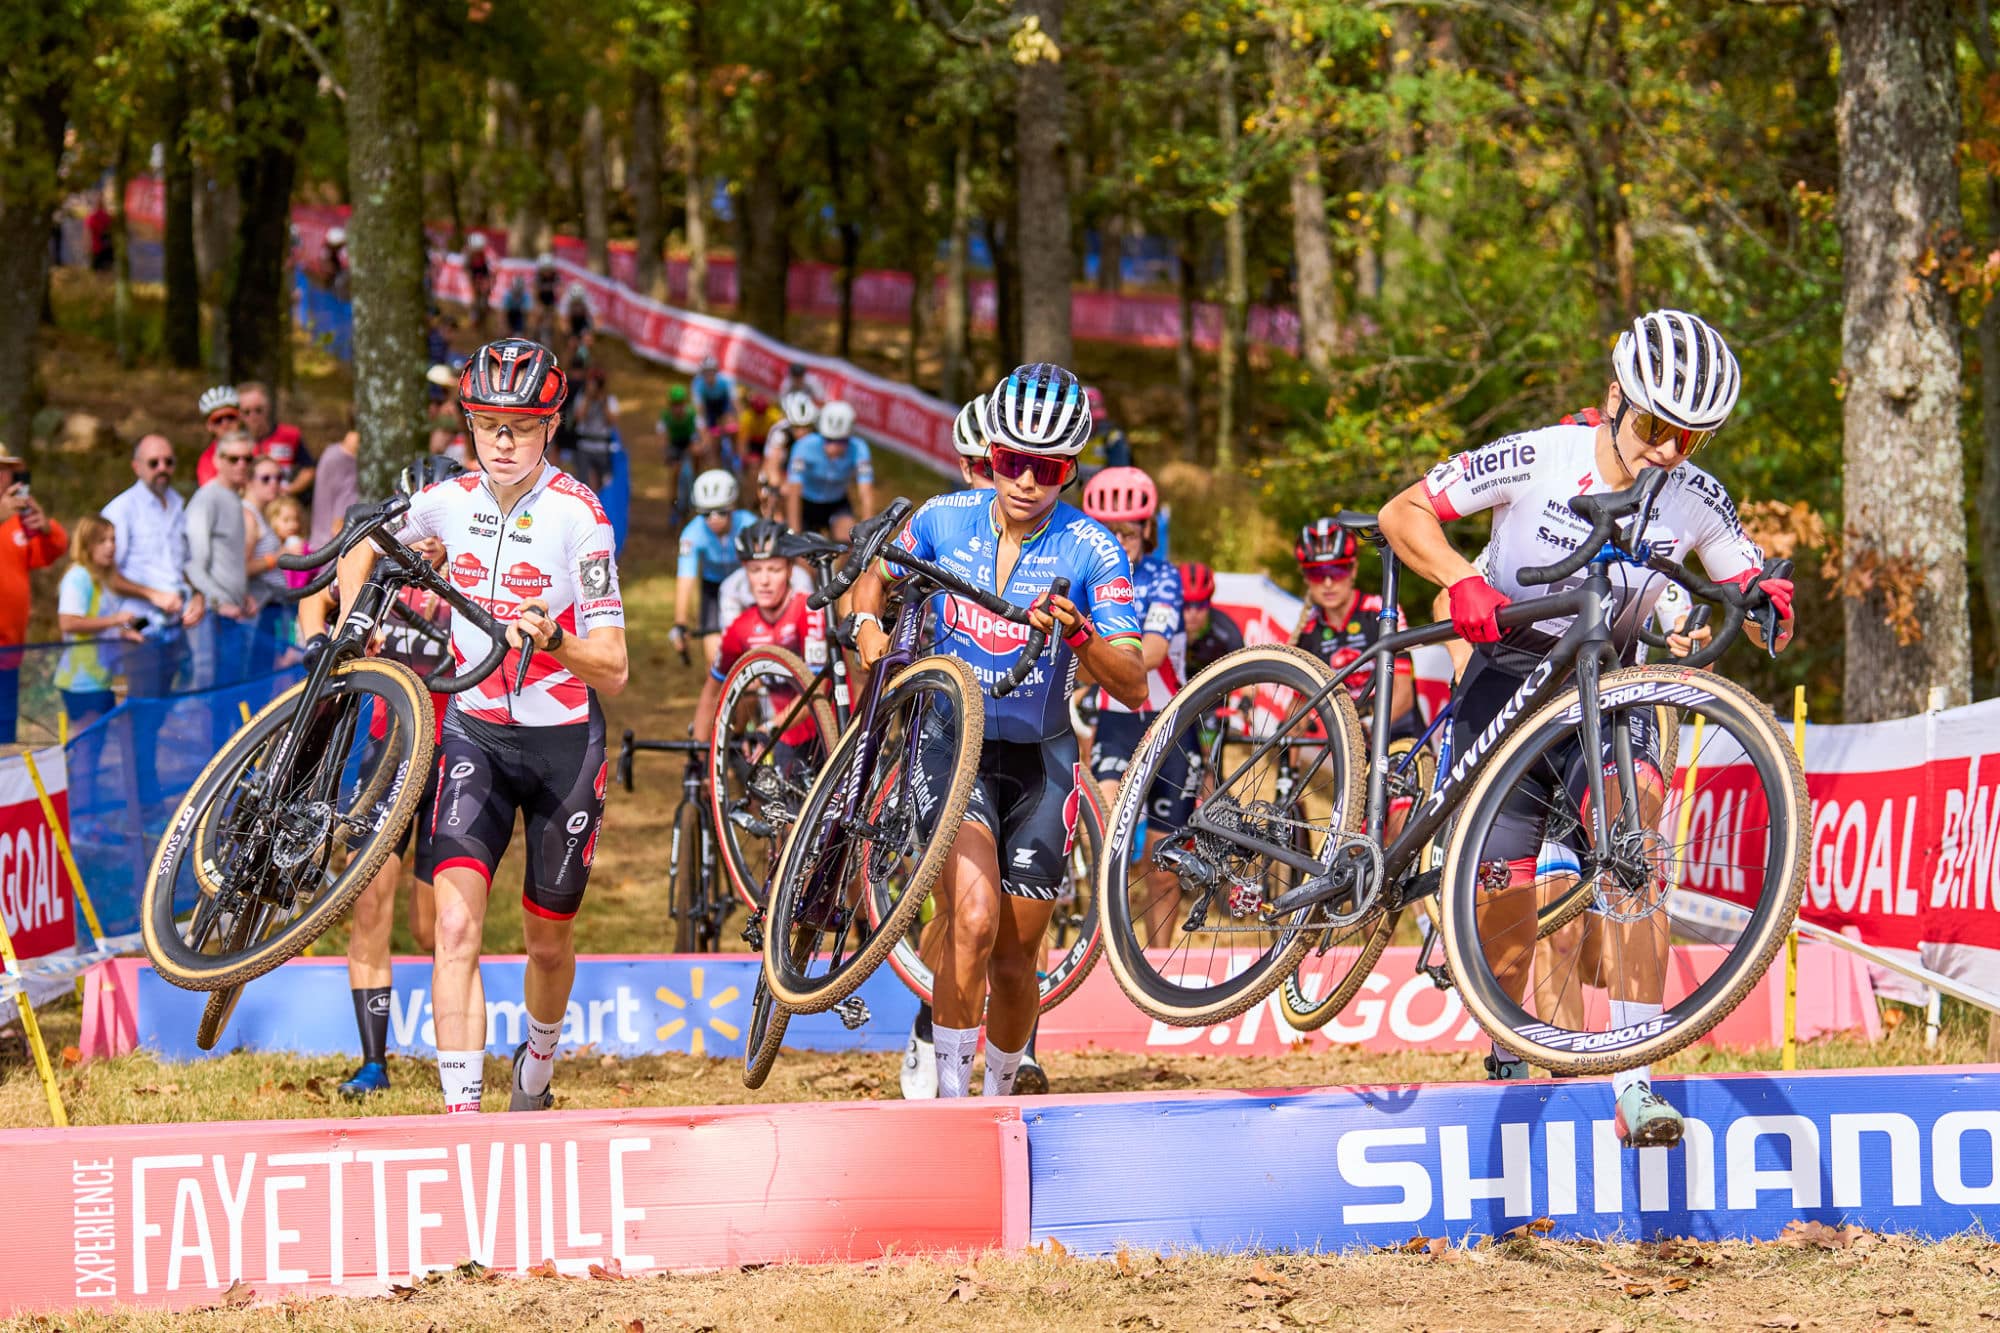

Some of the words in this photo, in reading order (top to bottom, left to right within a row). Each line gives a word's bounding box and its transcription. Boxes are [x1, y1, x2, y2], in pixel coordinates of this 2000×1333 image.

[1499, 476, 1512, 485] VOS
[478, 513, 498, 525] UCI
[1066, 518, 1121, 569] Alpecin
[451, 564, 487, 580] Pauwels
[504, 576, 550, 587] Pauwels
[589, 565, 606, 588] 9
[1567, 682, 1658, 719] EORIDE
[388, 760, 409, 803] SWISS
[181, 806, 195, 831] DT
[158, 834, 181, 875] SWISS
[1801, 795, 1919, 916] GOAL
[1571, 1018, 1665, 1051] EVORIDE
[1337, 1109, 2000, 1225] SHIMANO
[73, 1156, 117, 1298] EXPERIENCE
[132, 1137, 655, 1294] FAYETTEVILLE
